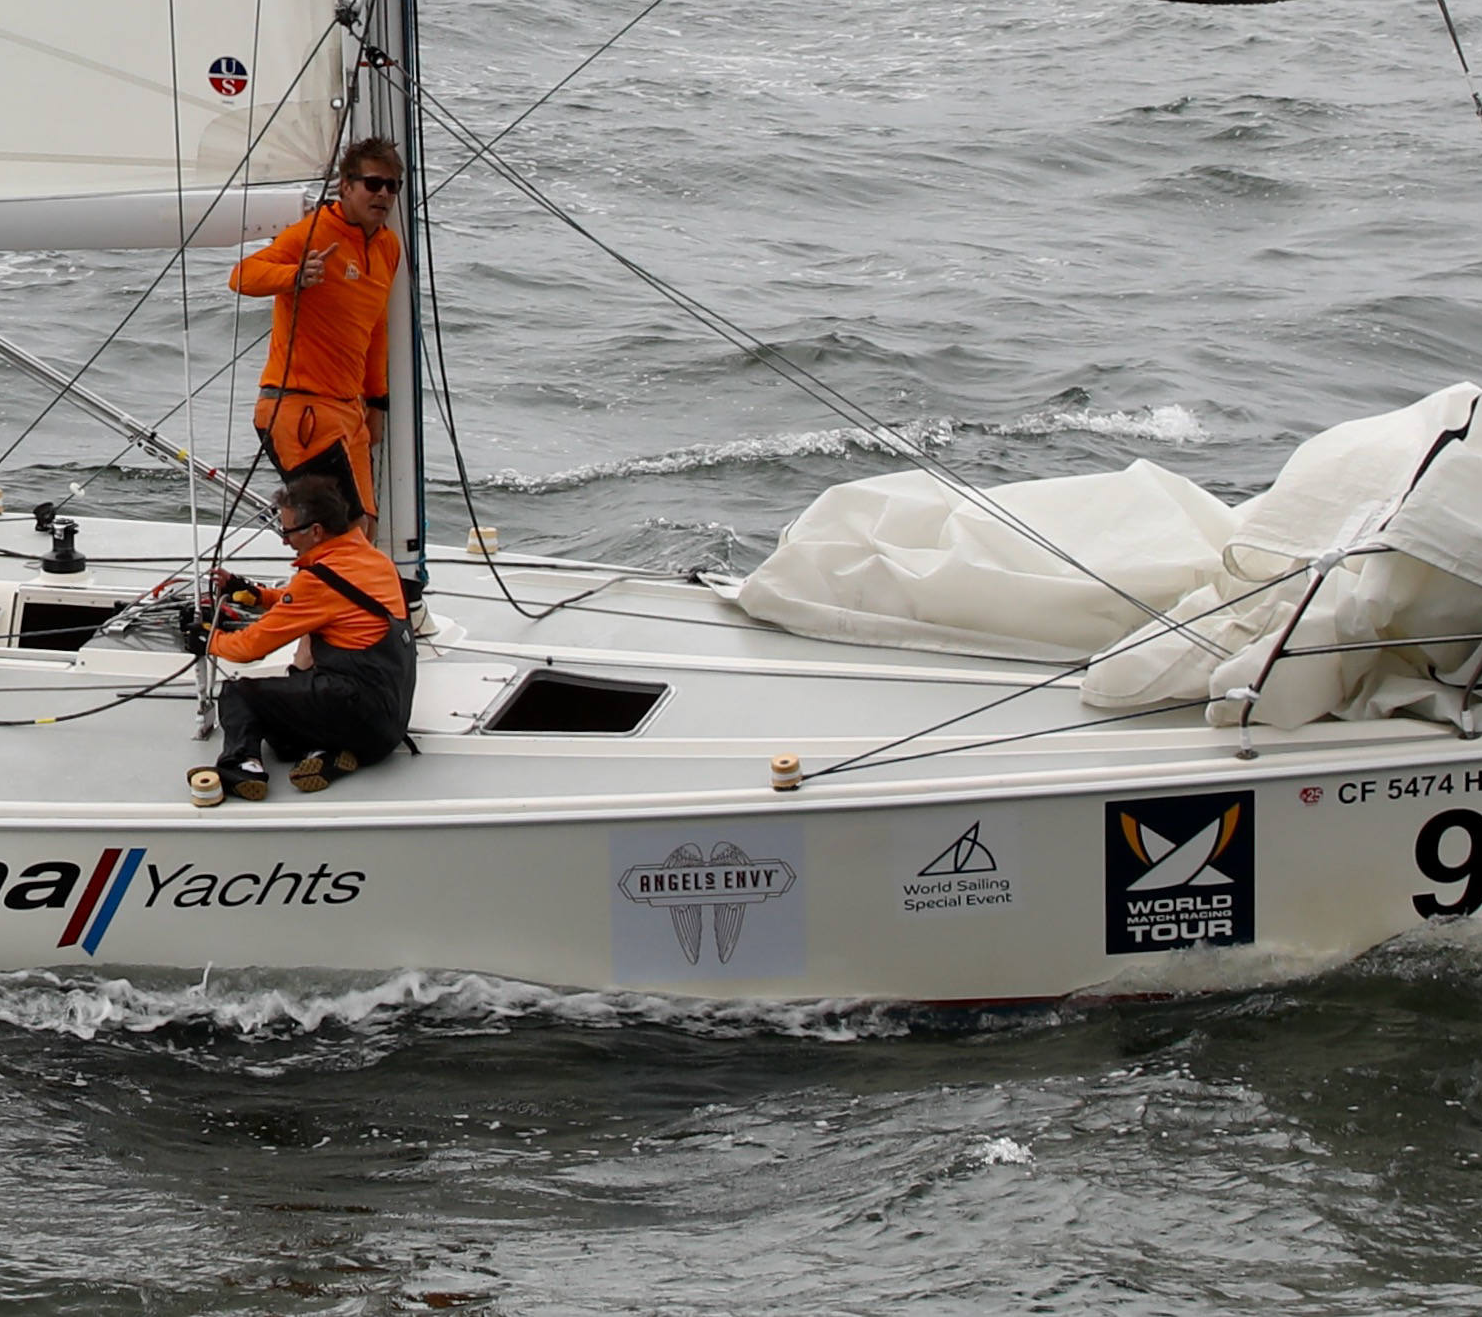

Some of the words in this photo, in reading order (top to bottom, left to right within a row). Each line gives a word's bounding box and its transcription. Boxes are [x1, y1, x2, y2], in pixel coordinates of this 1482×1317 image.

[1338, 780, 1376, 804] CF
[1388, 773, 1454, 800] 5474
[144, 862, 366, 908] Yachts
[903, 880, 952, 895] World
[957, 878, 1010, 892] Sailing
[904, 895, 961, 912] Special
[966, 893, 1012, 906] Event
[1127, 895, 1232, 915] WORLD
[1127, 914, 1176, 924] MATCH
[1179, 910, 1232, 920] RACING
[1127, 919, 1232, 943] TOUR
